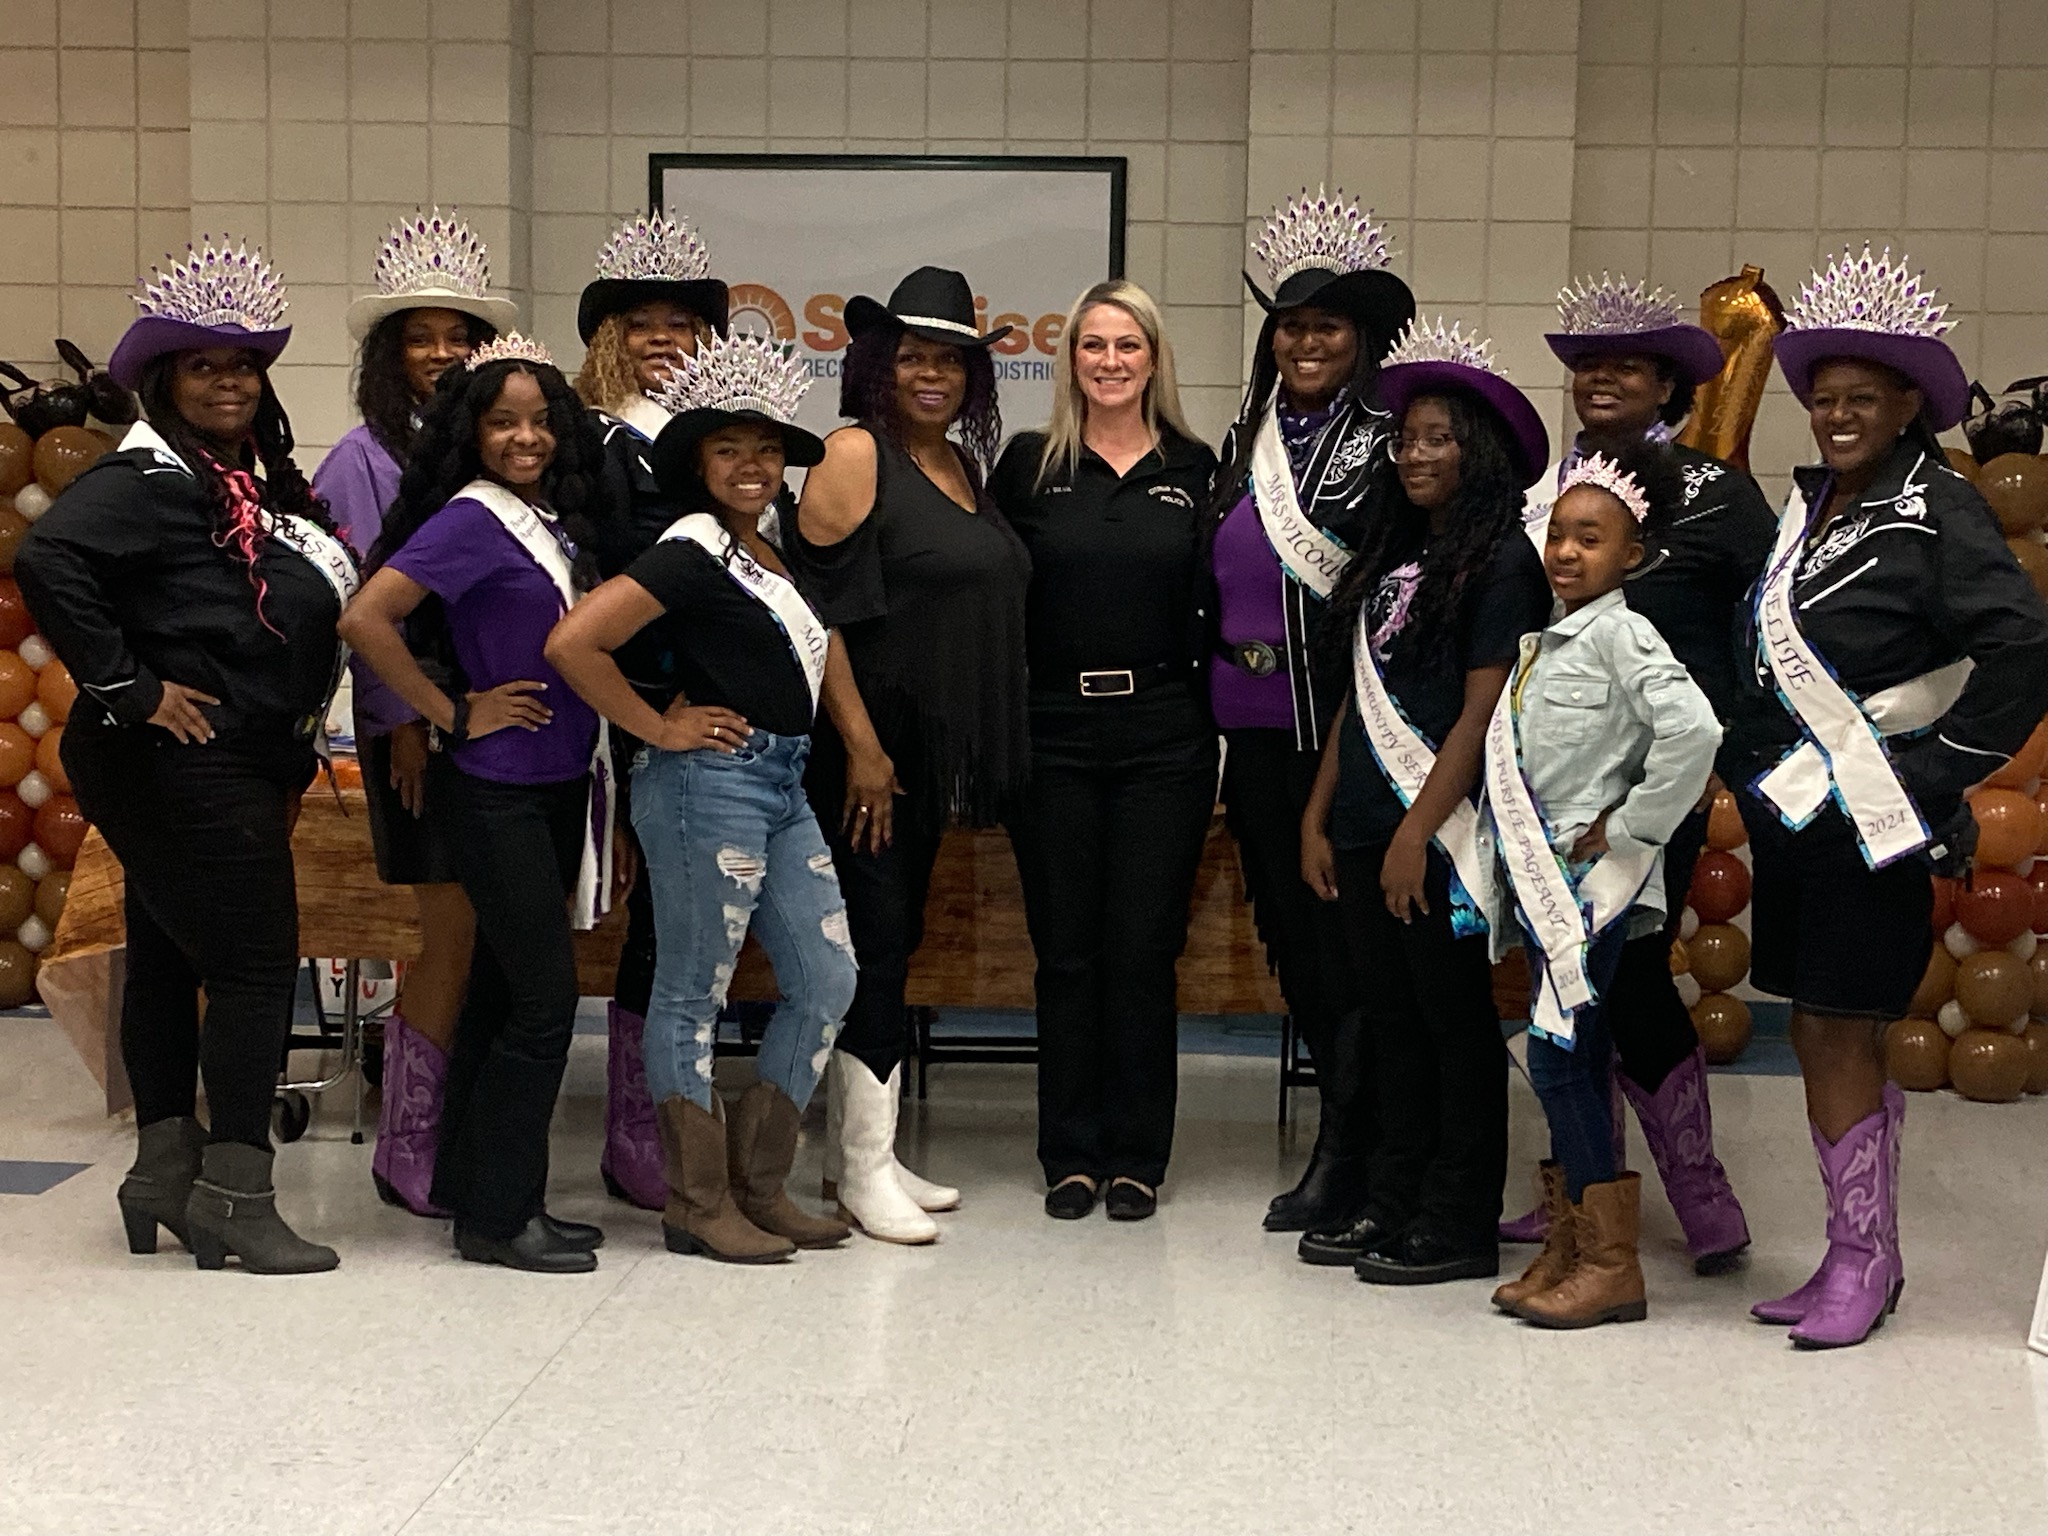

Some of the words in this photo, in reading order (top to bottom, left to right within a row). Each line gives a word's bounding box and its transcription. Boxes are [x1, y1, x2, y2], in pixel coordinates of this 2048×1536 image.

[802, 293, 1067, 355] Sise
[993, 361, 1056, 380] DISTRI
[1281, 516, 1341, 579] VICOU
[1766, 592, 1816, 690] ELITE
[1398, 753, 1428, 790] SER
[1496, 758, 1526, 832] PURPLE
[1518, 836, 1570, 927] PAGEANT
